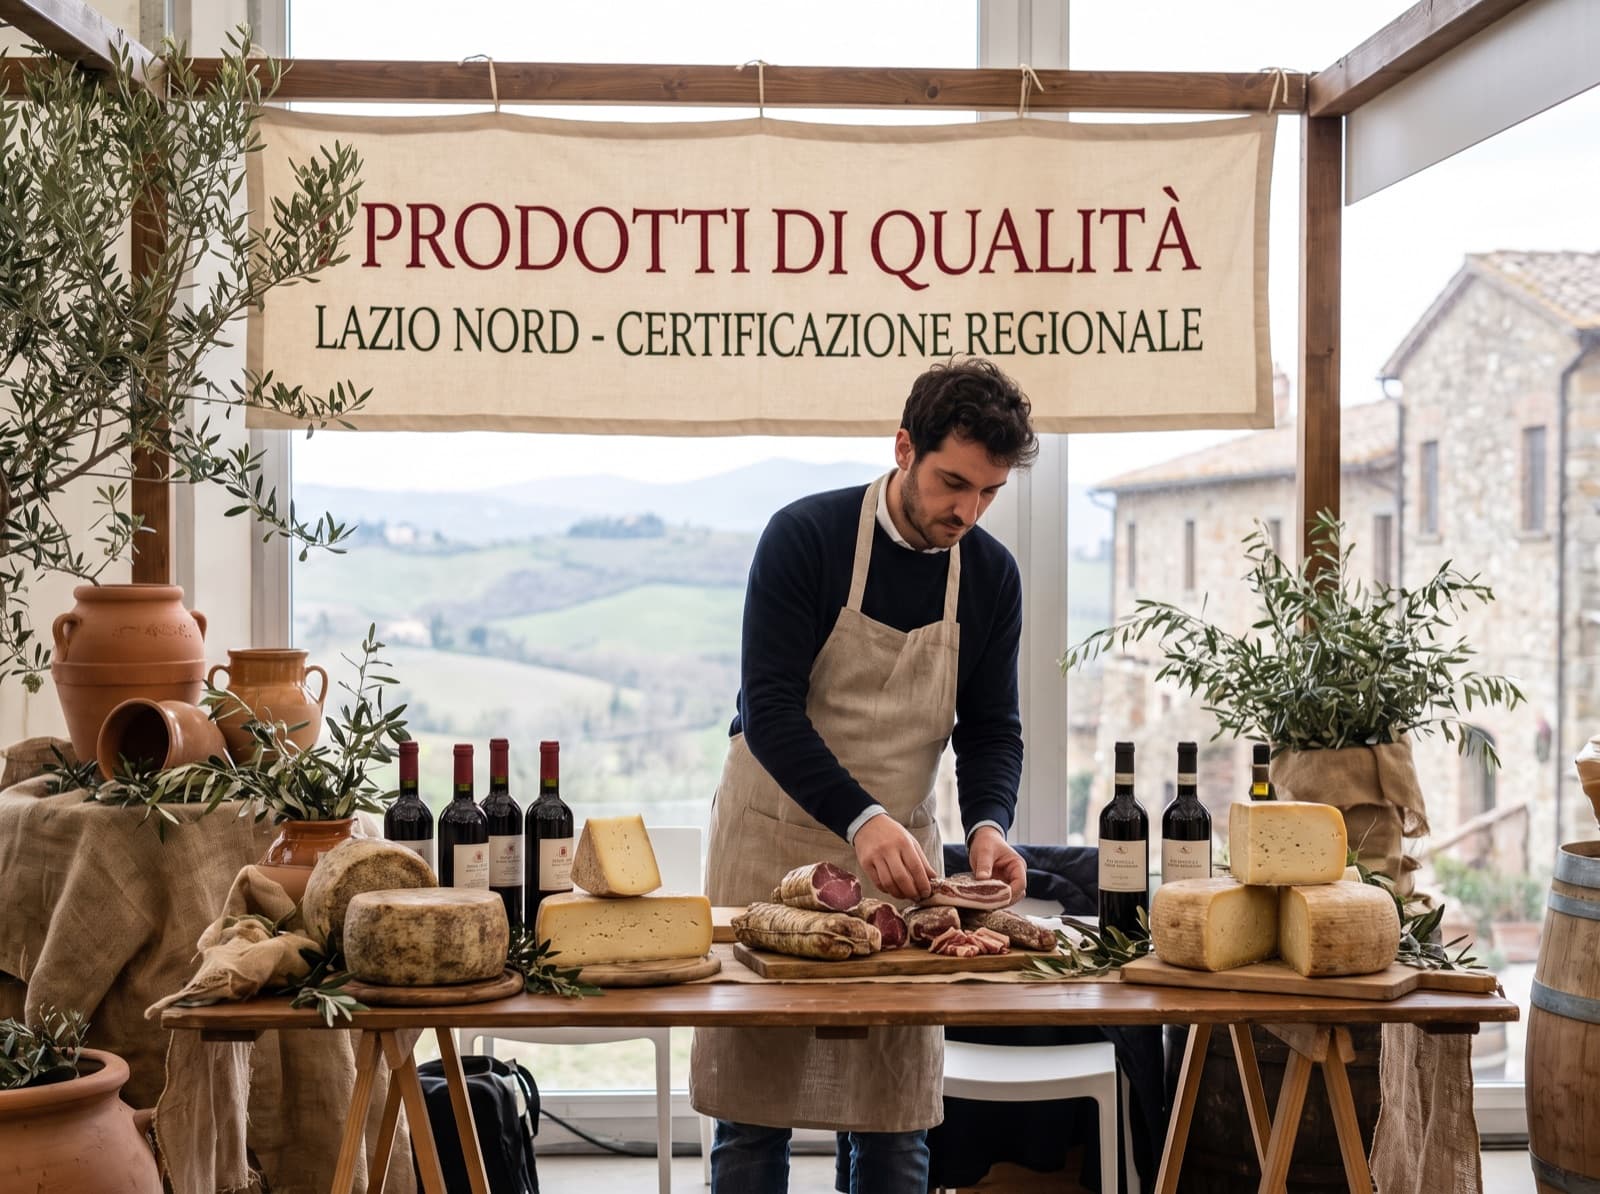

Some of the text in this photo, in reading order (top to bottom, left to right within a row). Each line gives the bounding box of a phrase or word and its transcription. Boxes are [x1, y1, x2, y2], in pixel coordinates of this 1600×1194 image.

[361, 202, 749, 274] PRODOTTI
[772, 208, 848, 275] DI
[869, 185, 1202, 292] QUALITÀ
[315, 304, 441, 352] LAZIO
[453, 307, 580, 354] NORD
[616, 310, 954, 358] CERTIFICAZIONE
[965, 308, 1204, 356] REGIONALE
